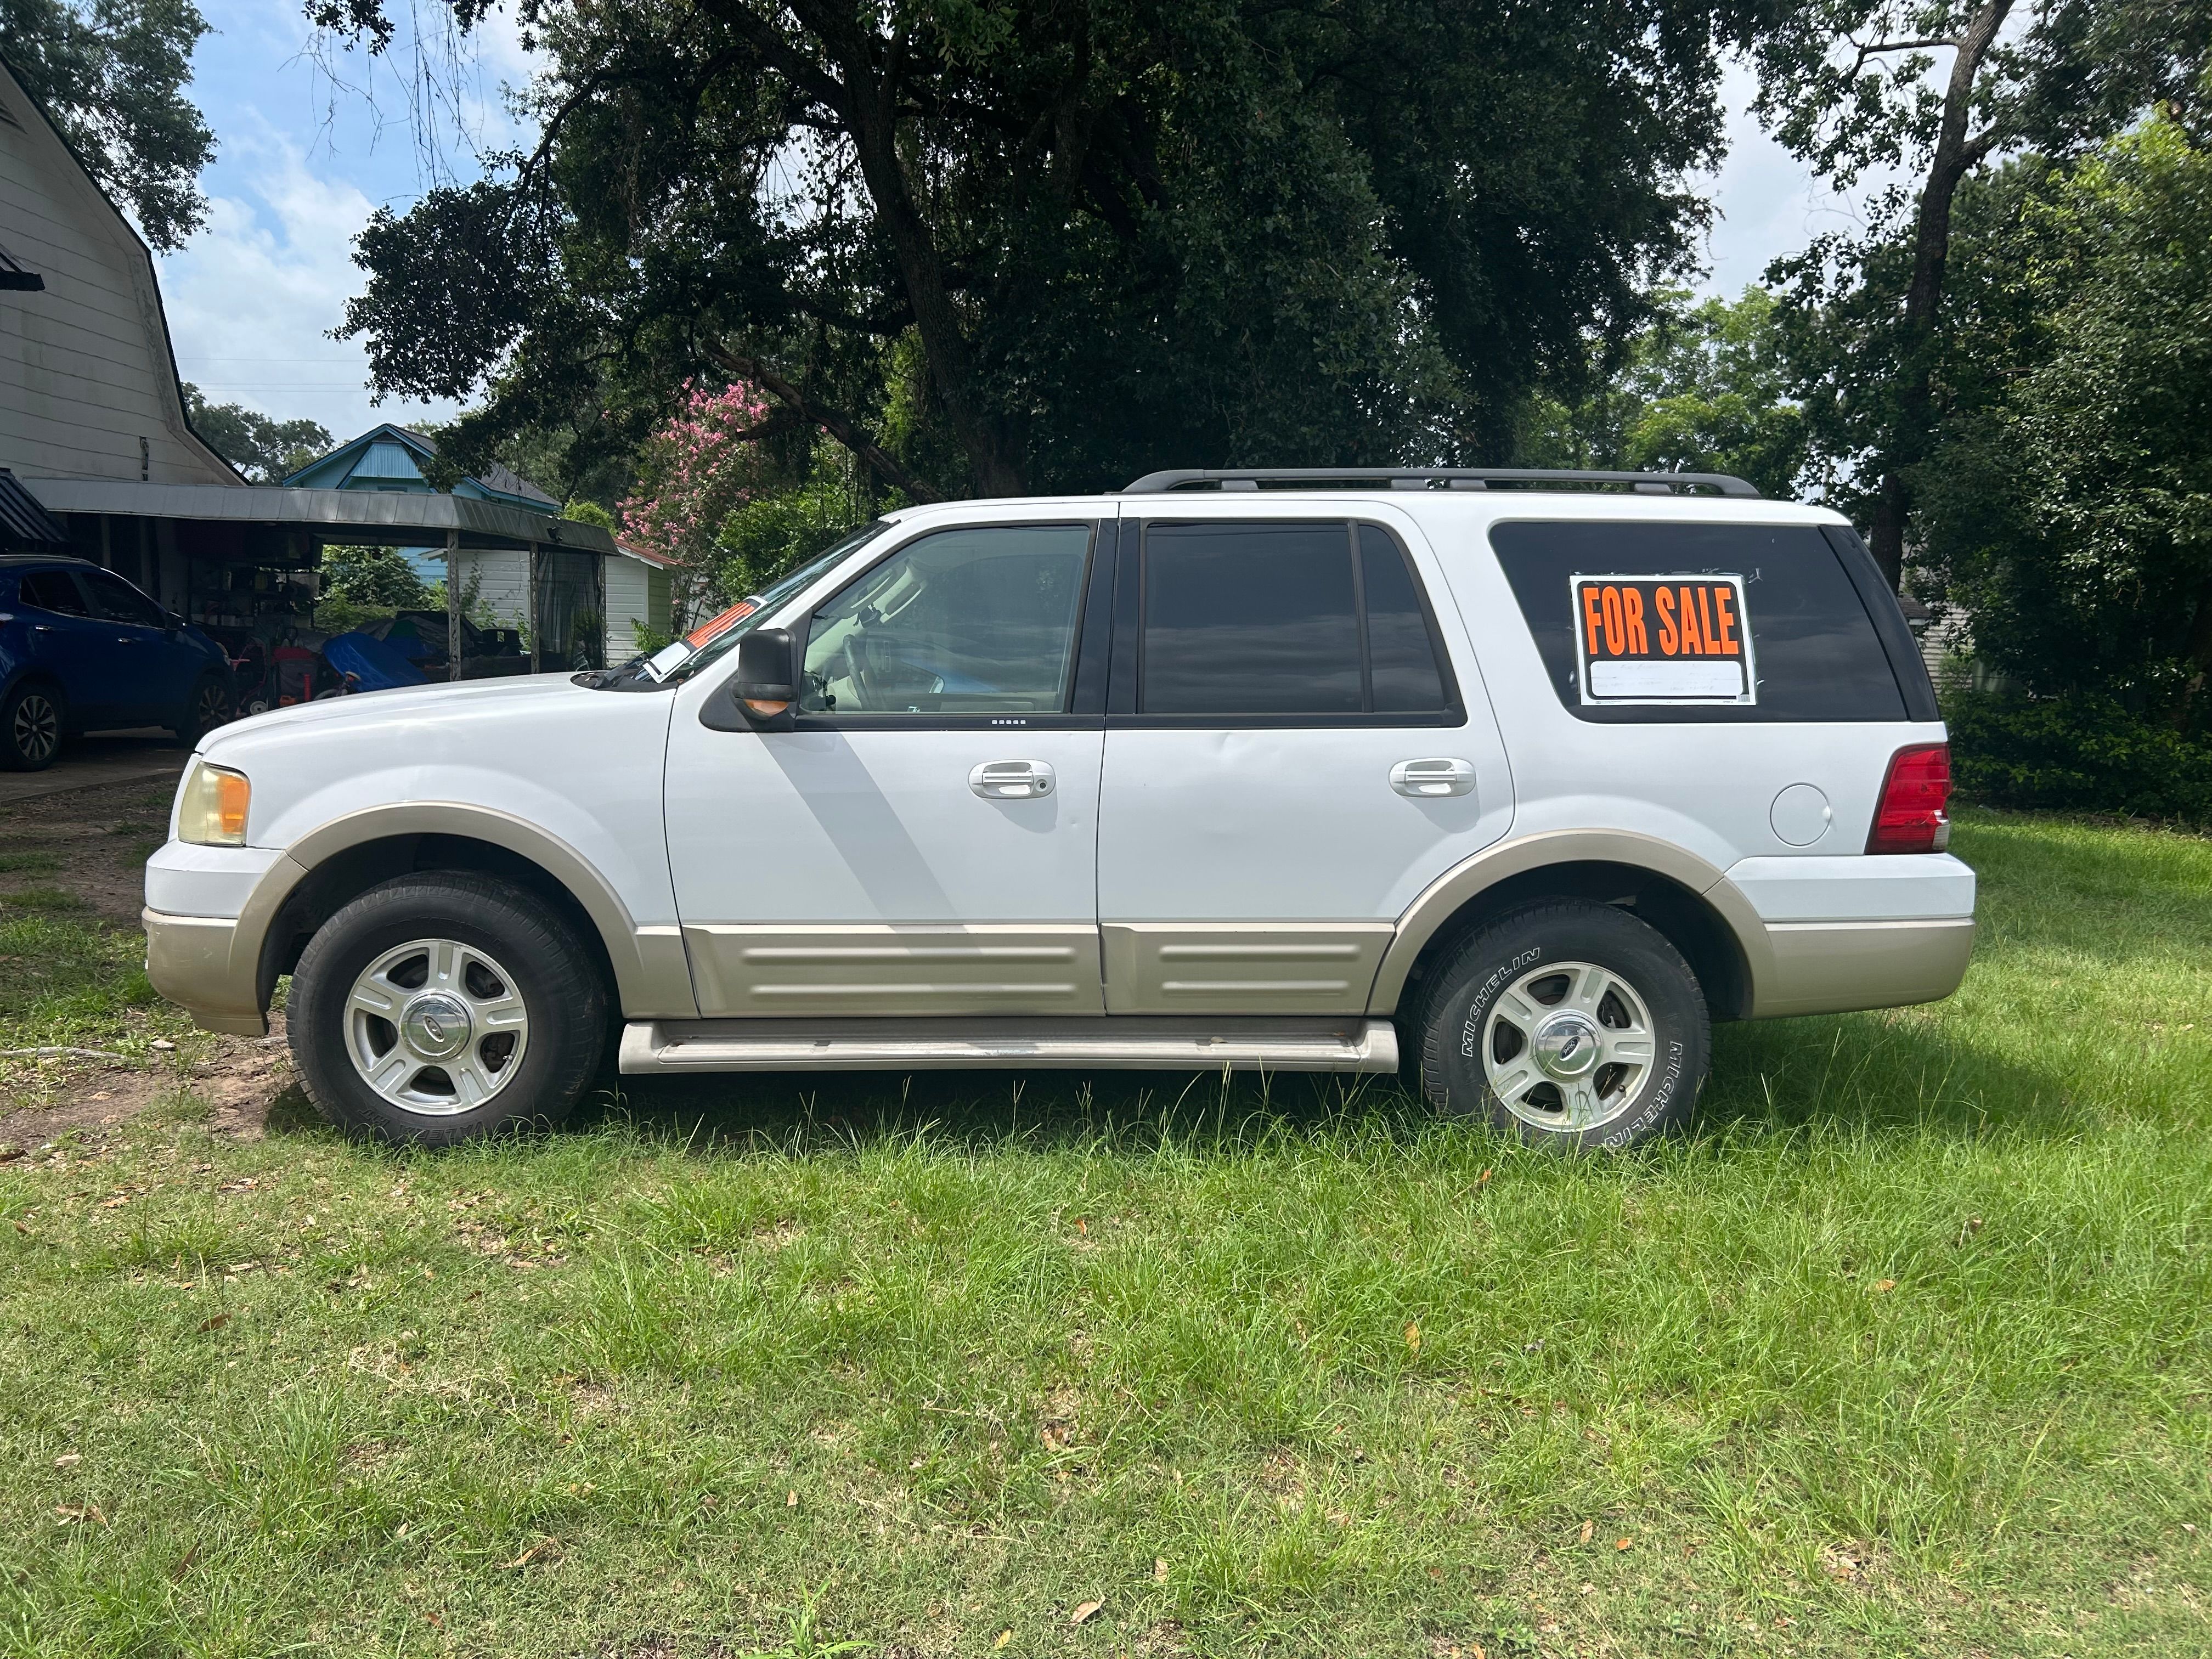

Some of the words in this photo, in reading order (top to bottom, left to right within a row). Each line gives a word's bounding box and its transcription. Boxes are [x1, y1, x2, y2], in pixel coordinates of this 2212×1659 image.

[1583, 586, 1648, 655] FOR
[1655, 586, 1739, 655] SALE
[1462, 947, 1540, 1057] MICHELIN
[1604, 1041, 1683, 1147] MICHELIN
